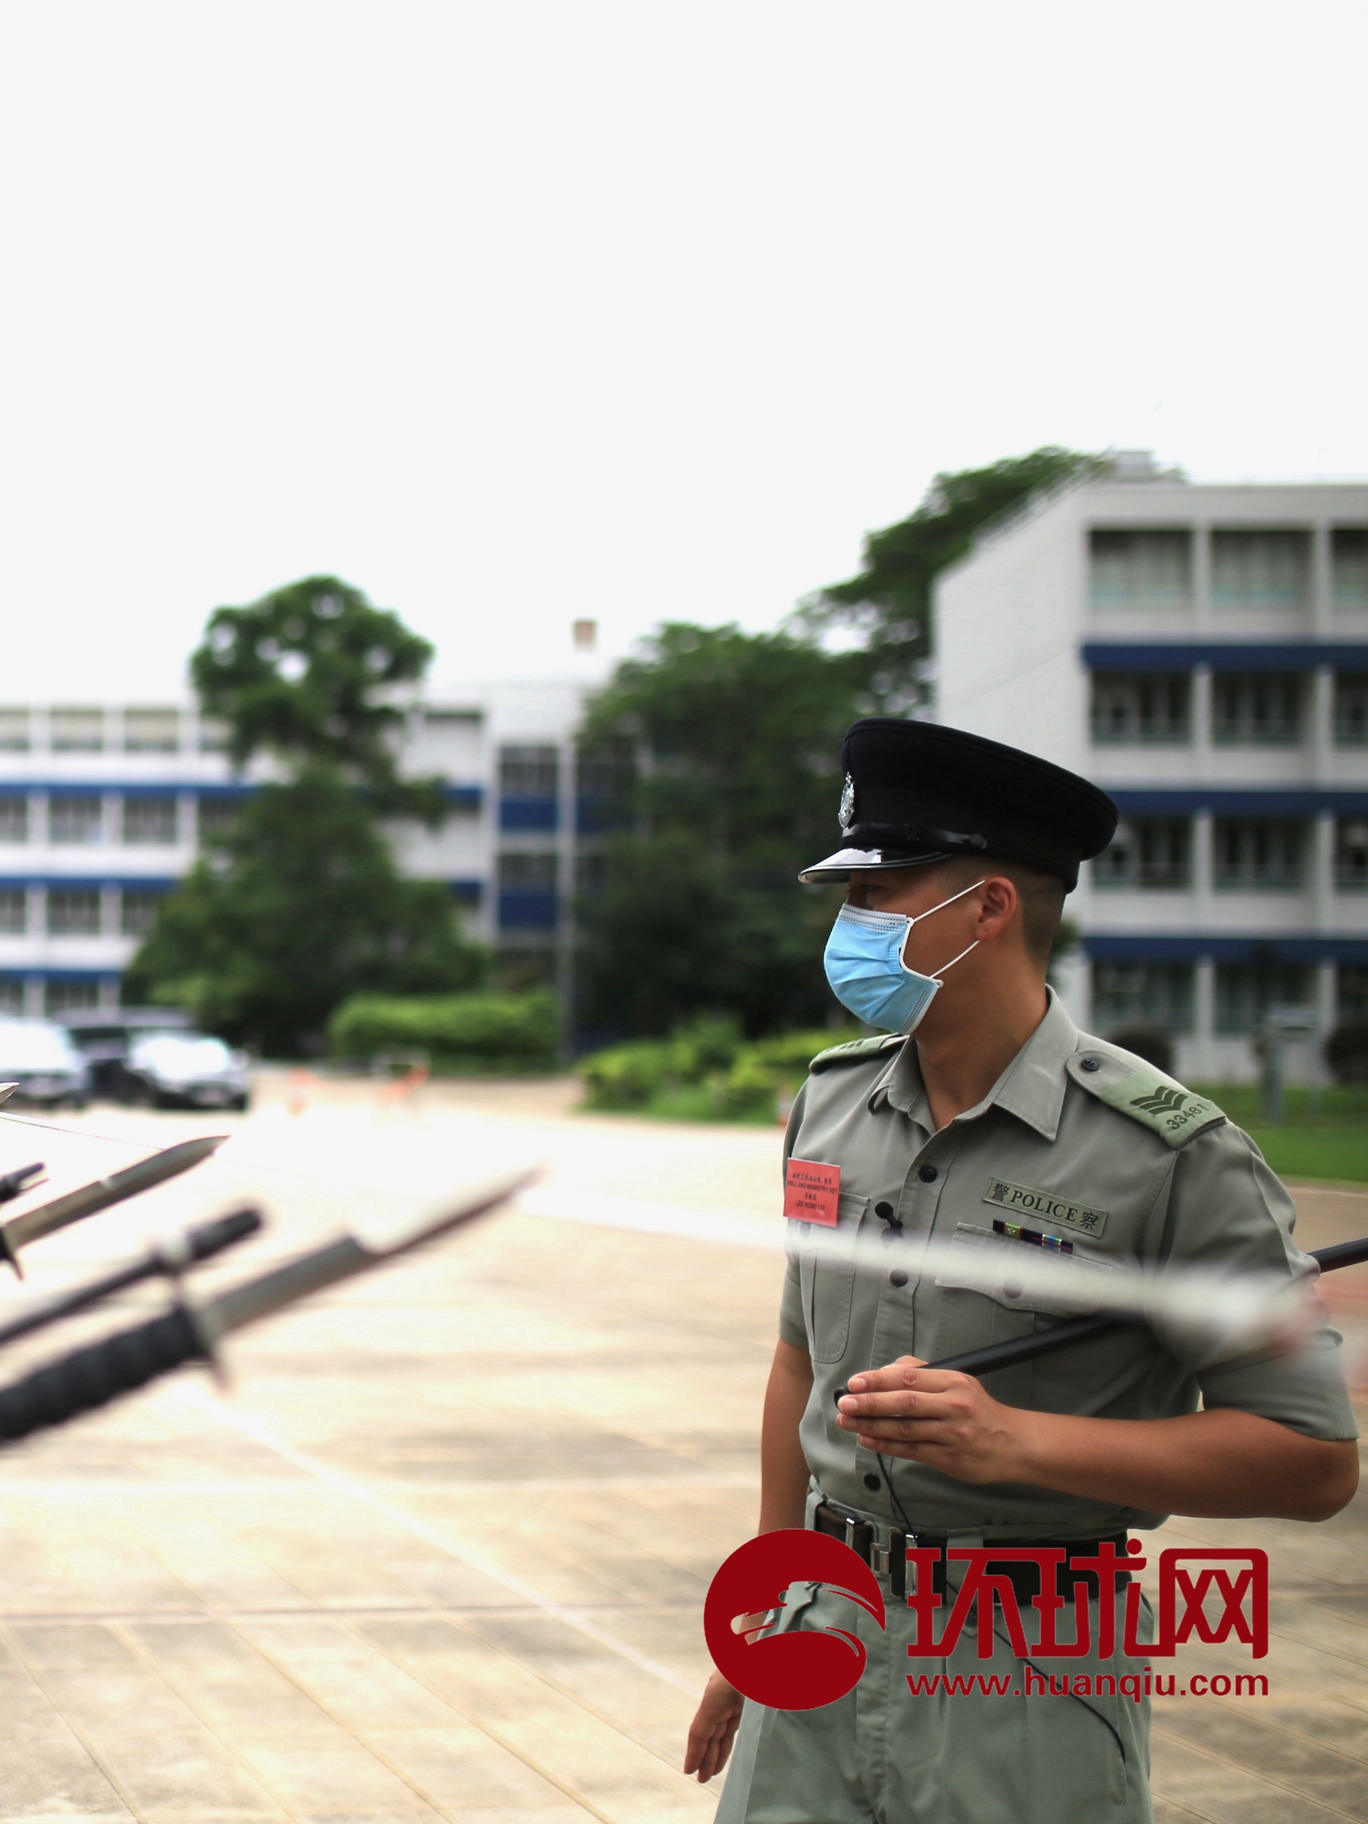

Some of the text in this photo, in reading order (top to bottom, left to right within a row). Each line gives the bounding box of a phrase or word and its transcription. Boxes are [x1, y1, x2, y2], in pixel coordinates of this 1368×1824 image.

[1166, 1103, 1210, 1130] 33481
[992, 1183, 1099, 1230] 警 POLICE 察
